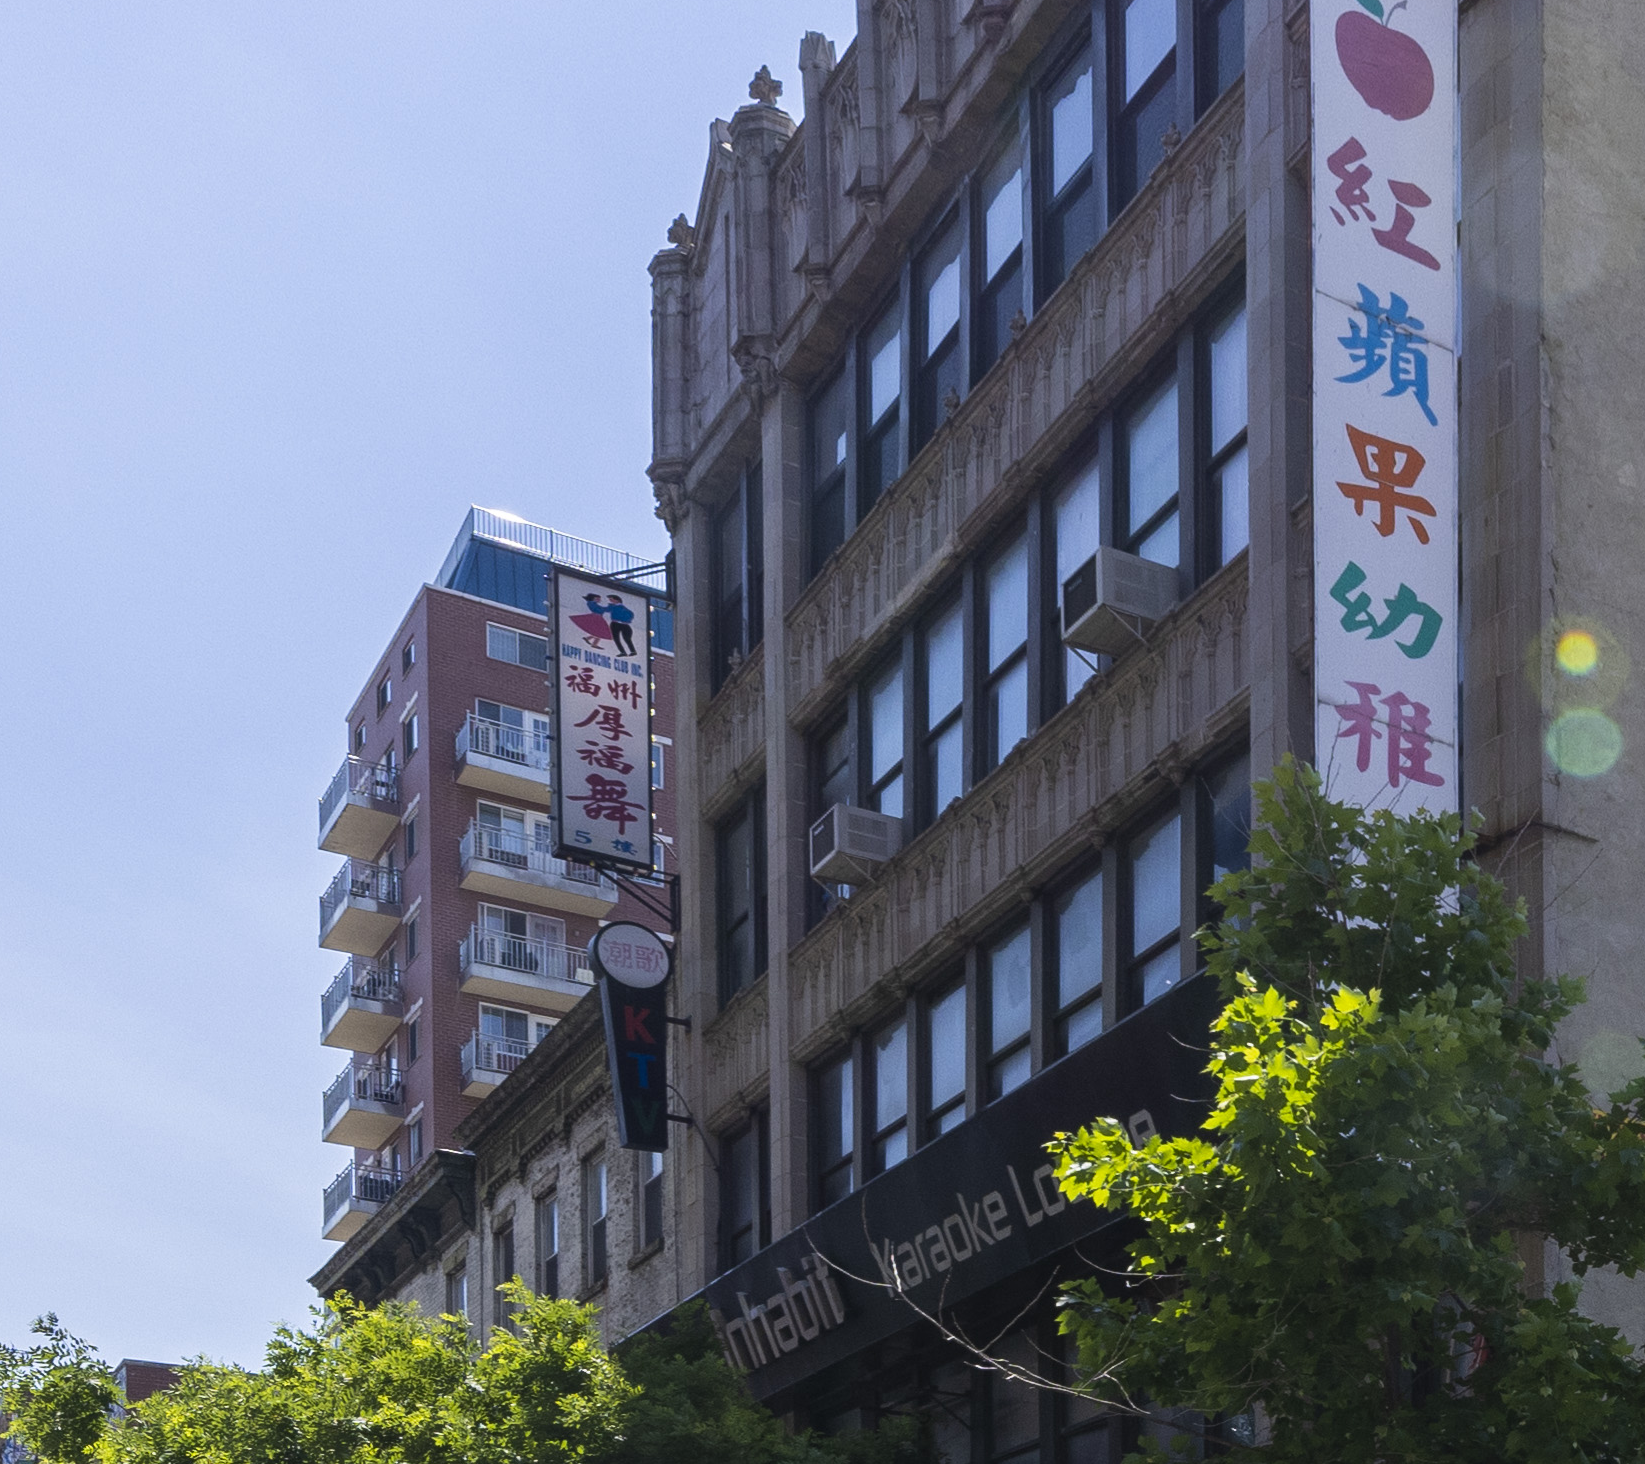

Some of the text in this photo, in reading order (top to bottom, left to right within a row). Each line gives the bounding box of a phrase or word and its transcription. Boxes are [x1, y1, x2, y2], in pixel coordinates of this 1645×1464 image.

[562, 643, 582, 662] HAPPY
[584, 648, 612, 669] DANCING
[614, 658, 629, 674] CLUB
[574, 830, 592, 845] 5
[623, 1005, 661, 1137] KTV
[870, 1191, 1013, 1298] Karaoke
